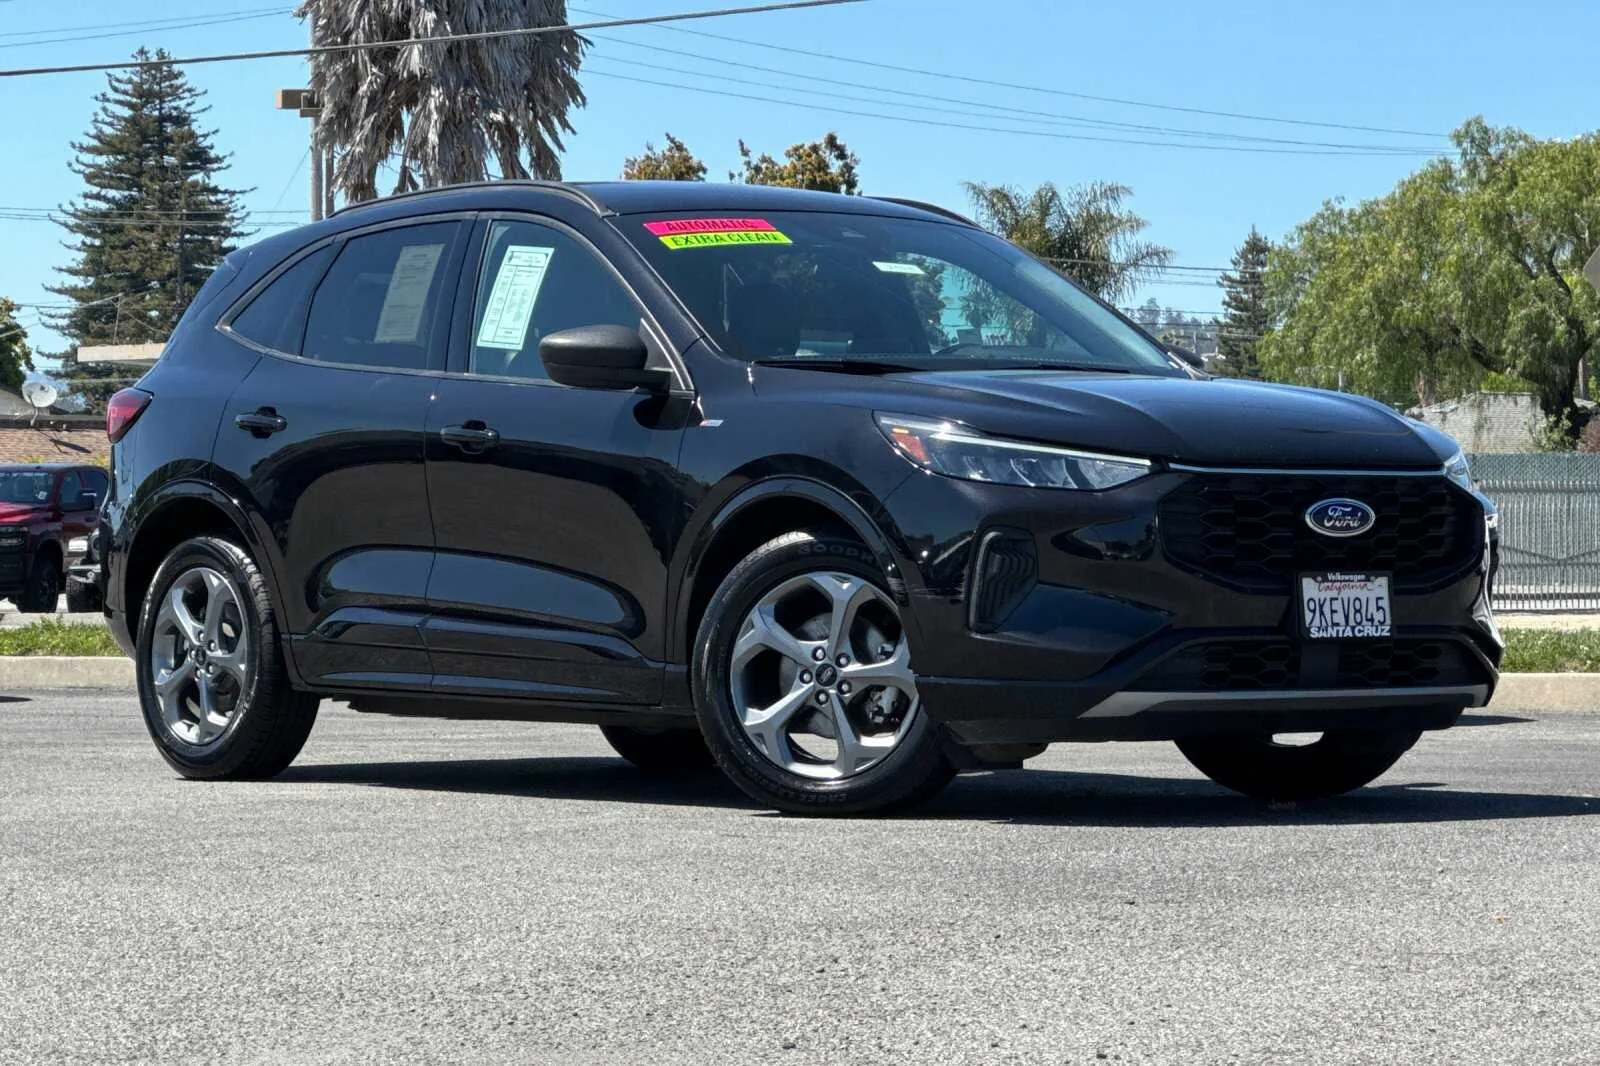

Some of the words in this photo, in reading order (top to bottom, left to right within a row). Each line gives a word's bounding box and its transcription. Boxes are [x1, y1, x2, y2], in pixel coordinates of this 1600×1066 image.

[665, 219, 756, 232] AUTOMATIC
[671, 234, 728, 247] EXTRA
[730, 232, 778, 243] CLEAN
[1327, 572, 1367, 582] Volkswagen
[1318, 581, 1374, 596] California
[1307, 597, 1386, 627] 9KEV845
[1309, 626, 1353, 639] SANTA
[1354, 625, 1391, 637] CRUZ
